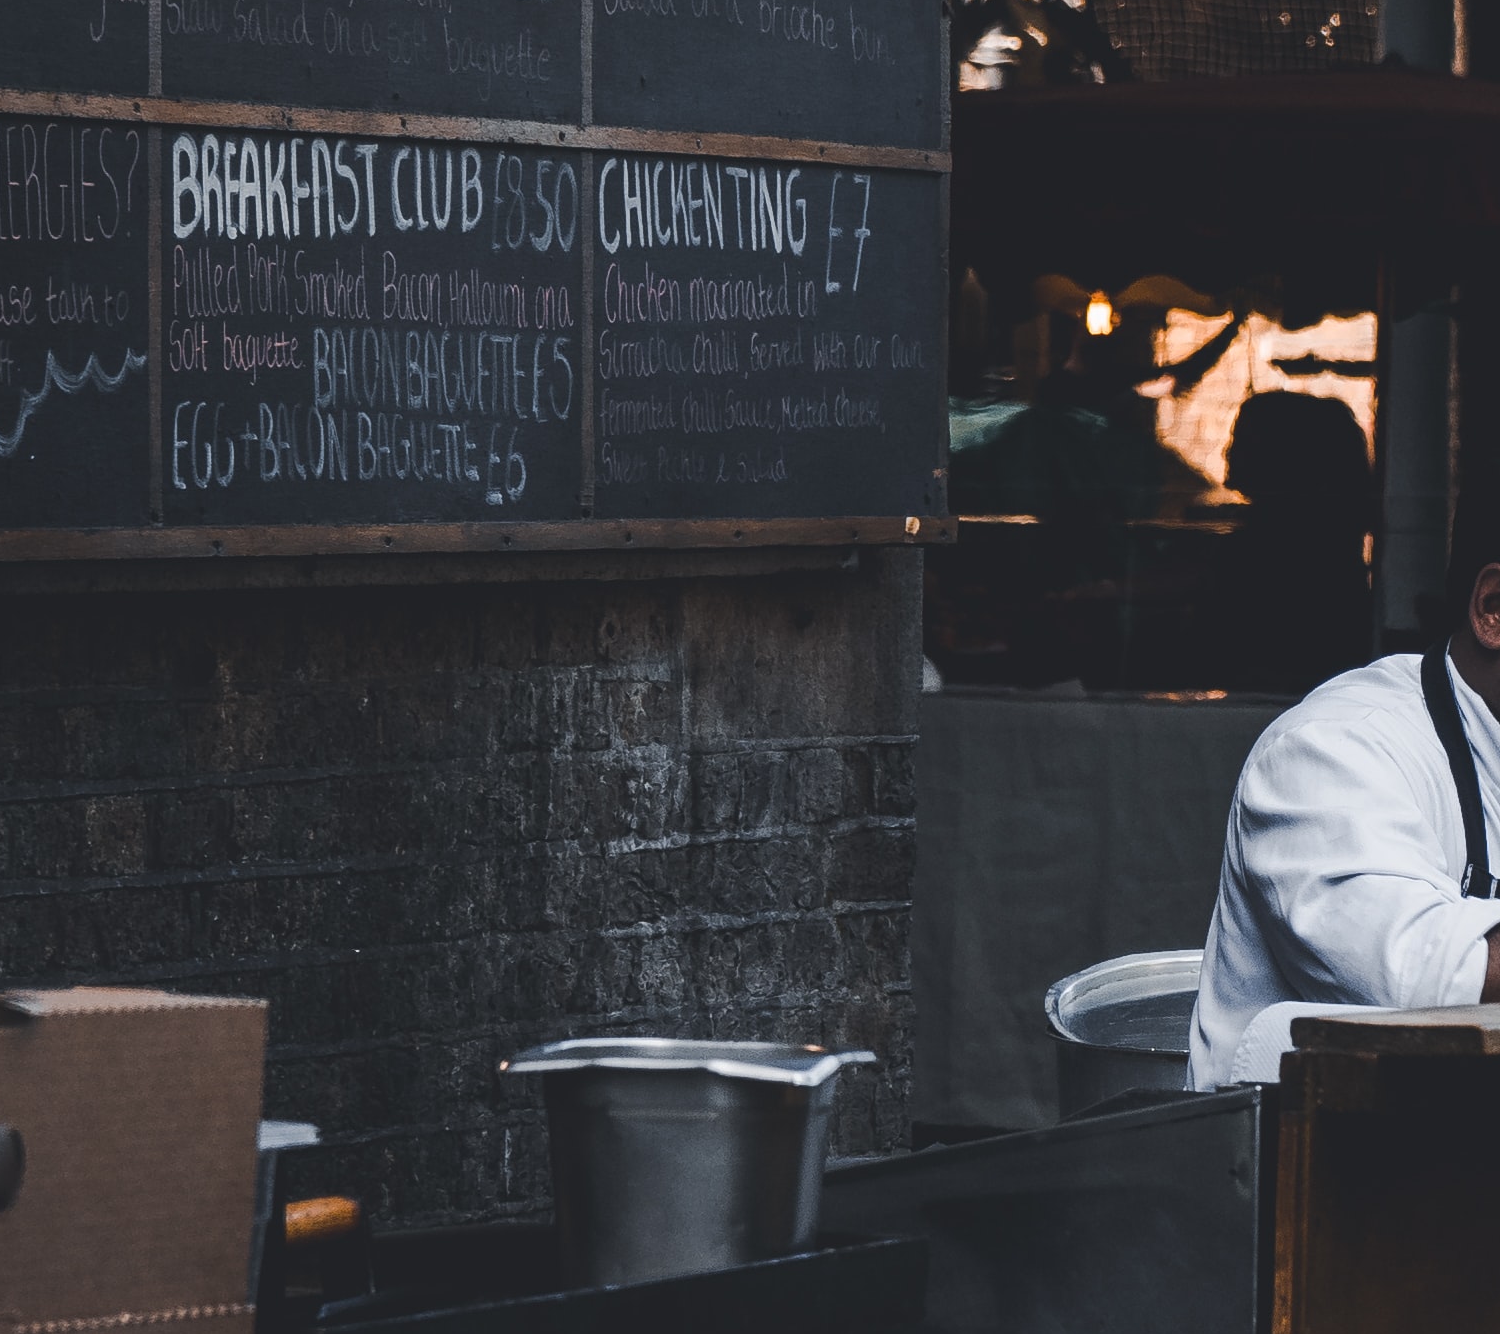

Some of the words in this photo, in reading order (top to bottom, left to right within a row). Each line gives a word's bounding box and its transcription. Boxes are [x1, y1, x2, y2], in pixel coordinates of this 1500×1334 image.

[172, 132, 379, 240] BREAKFAST
[390, 146, 484, 233] CLUB
[825, 170, 872, 293] £7
[44, 275, 100, 325] talk
[104, 281, 130, 325] to
[173, 243, 242, 319] Pulled
[294, 244, 370, 319] Smoked
[448, 267, 528, 328] Halloumi
[605, 260, 681, 324] Chicken
[690, 261, 791, 322] marinated
[798, 269, 818, 318] in
[312, 326, 400, 410] BACON
[404, 328, 527, 419] BAGUETTE
[530, 330, 574, 422] £5
[357, 410, 480, 483] BAGUETTE
[483, 422, 527, 506] £6
